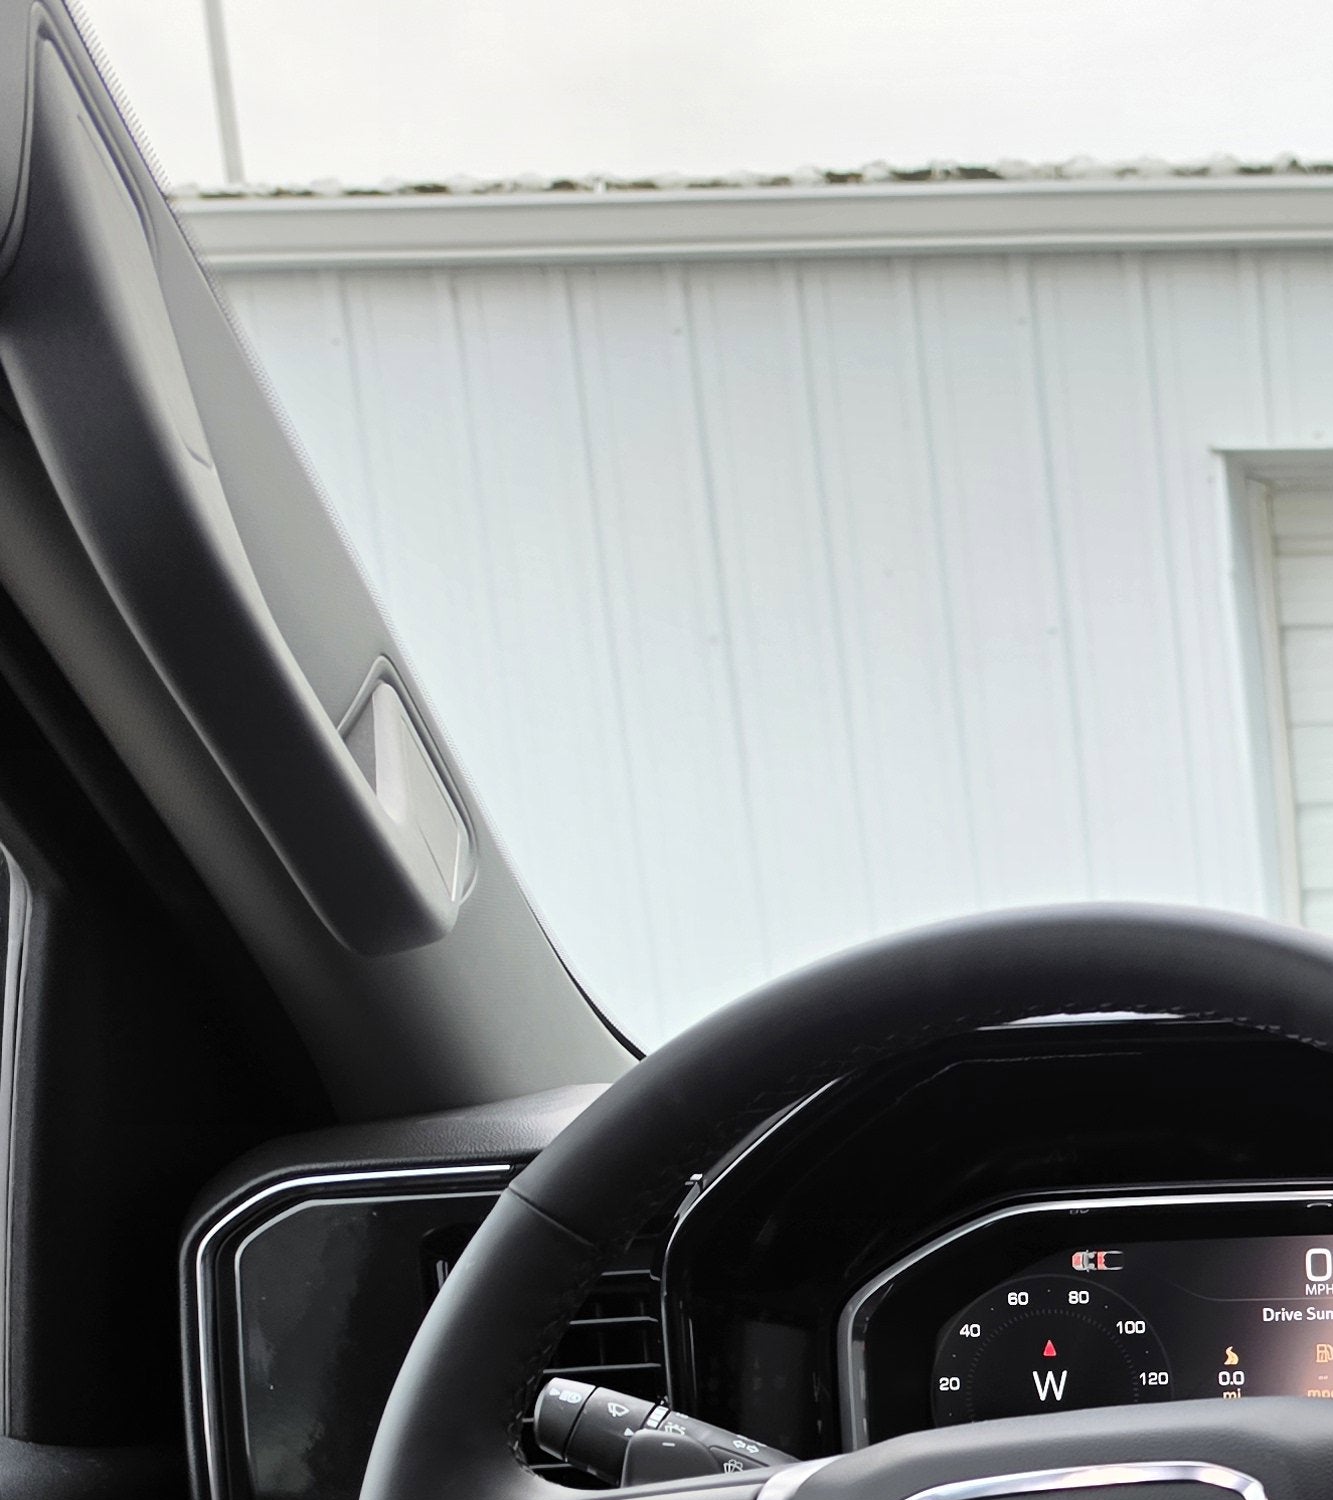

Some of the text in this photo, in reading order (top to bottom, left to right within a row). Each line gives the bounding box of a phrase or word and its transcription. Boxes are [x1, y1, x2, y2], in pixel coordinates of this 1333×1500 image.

[1305, 1248, 1332, 1282] 0
[1008, 1291, 1029, 1306] 60
[1068, 1290, 1090, 1305] 80
[1262, 1307, 1303, 1322] Drive
[959, 1323, 981, 1338] 40
[1116, 1320, 1146, 1334] 100
[939, 1377, 960, 1391] 20
[1139, 1372, 1169, 1386] 120
[1218, 1370, 1245, 1386] 0.0
[1032, 1370, 1068, 1402] W
